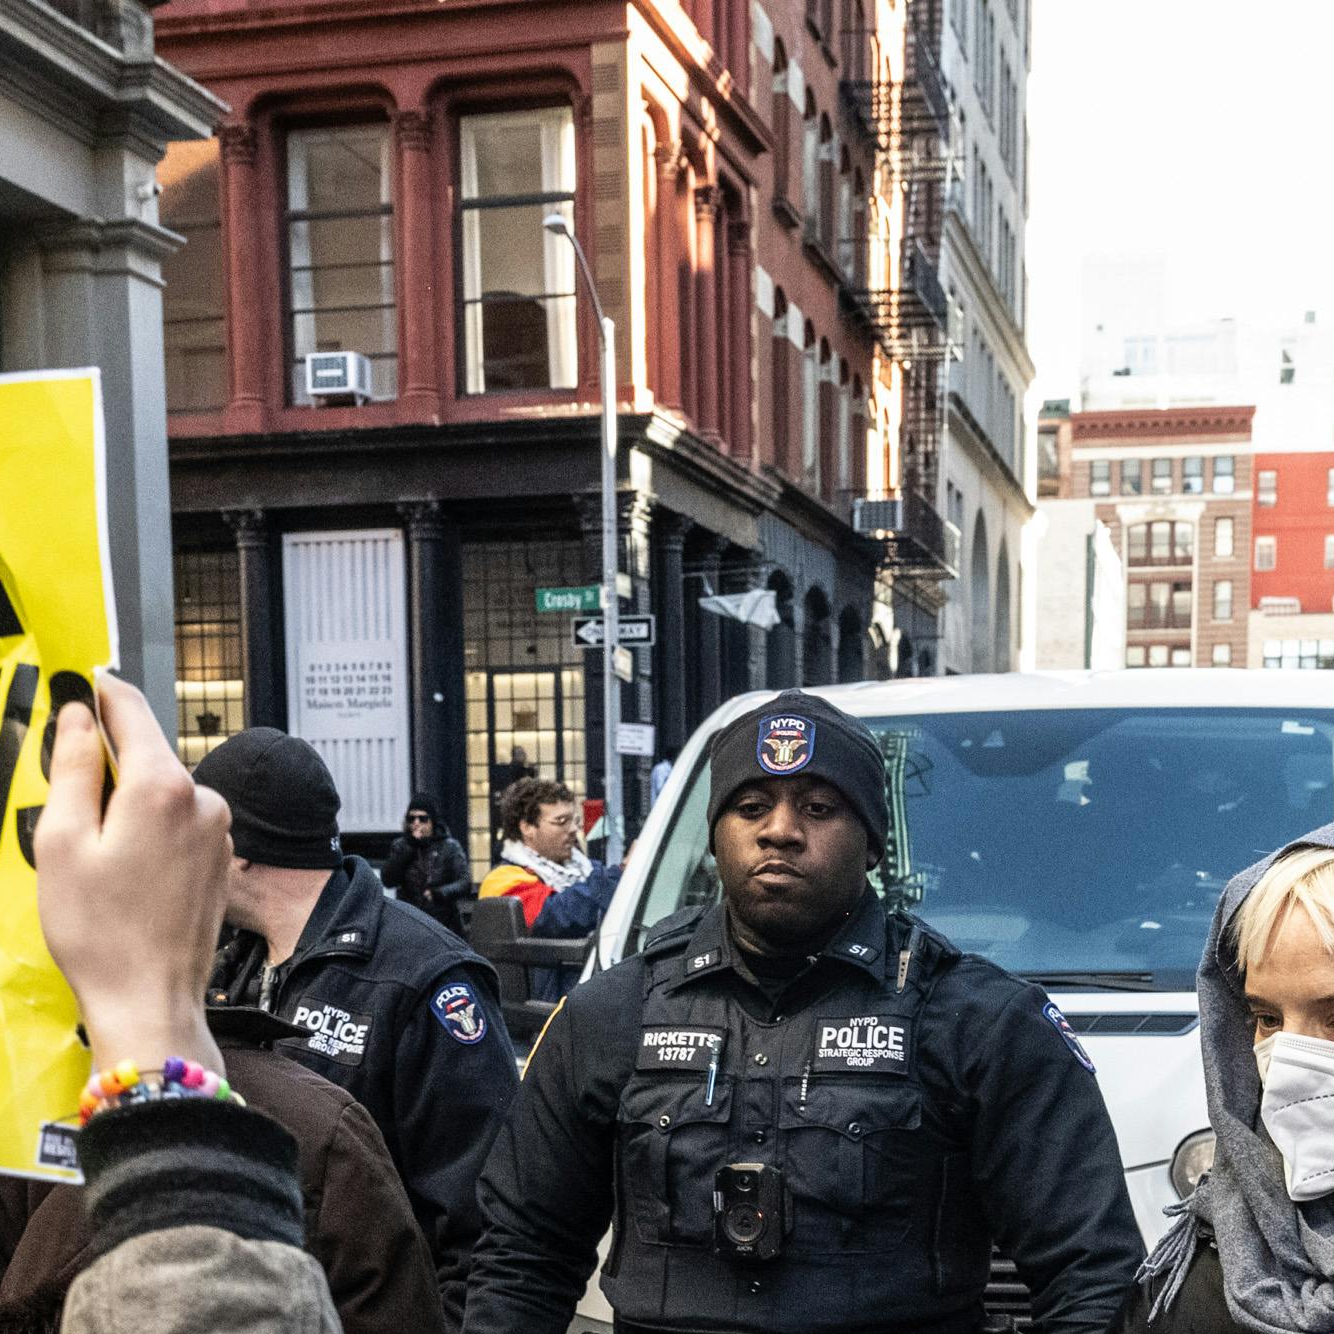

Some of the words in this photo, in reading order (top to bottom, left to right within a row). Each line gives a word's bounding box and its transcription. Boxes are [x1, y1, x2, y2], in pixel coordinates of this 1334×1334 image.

[543, 592, 582, 610] Crosby
[306, 699, 345, 710] Maison
[347, 697, 392, 710] Margiela
[770, 718, 805, 731] NYPD
[341, 932, 355, 943] S1
[849, 944, 869, 957] S1
[694, 954, 710, 968] S1
[436, 985, 471, 1009] POLICE
[323, 1004, 351, 1022] NYPD
[292, 1006, 369, 1045] POLICE
[849, 1016, 879, 1028] NYPD
[643, 1031, 719, 1048] RICKETTS
[820, 1026, 905, 1051] POLICE
[307, 1038, 340, 1057] GROUP
[657, 1046, 697, 1061] 13787
[818, 1048, 862, 1058] STRATEGIC
[862, 1049, 905, 1062] RESPONSE
[846, 1057, 875, 1067] GROUP
